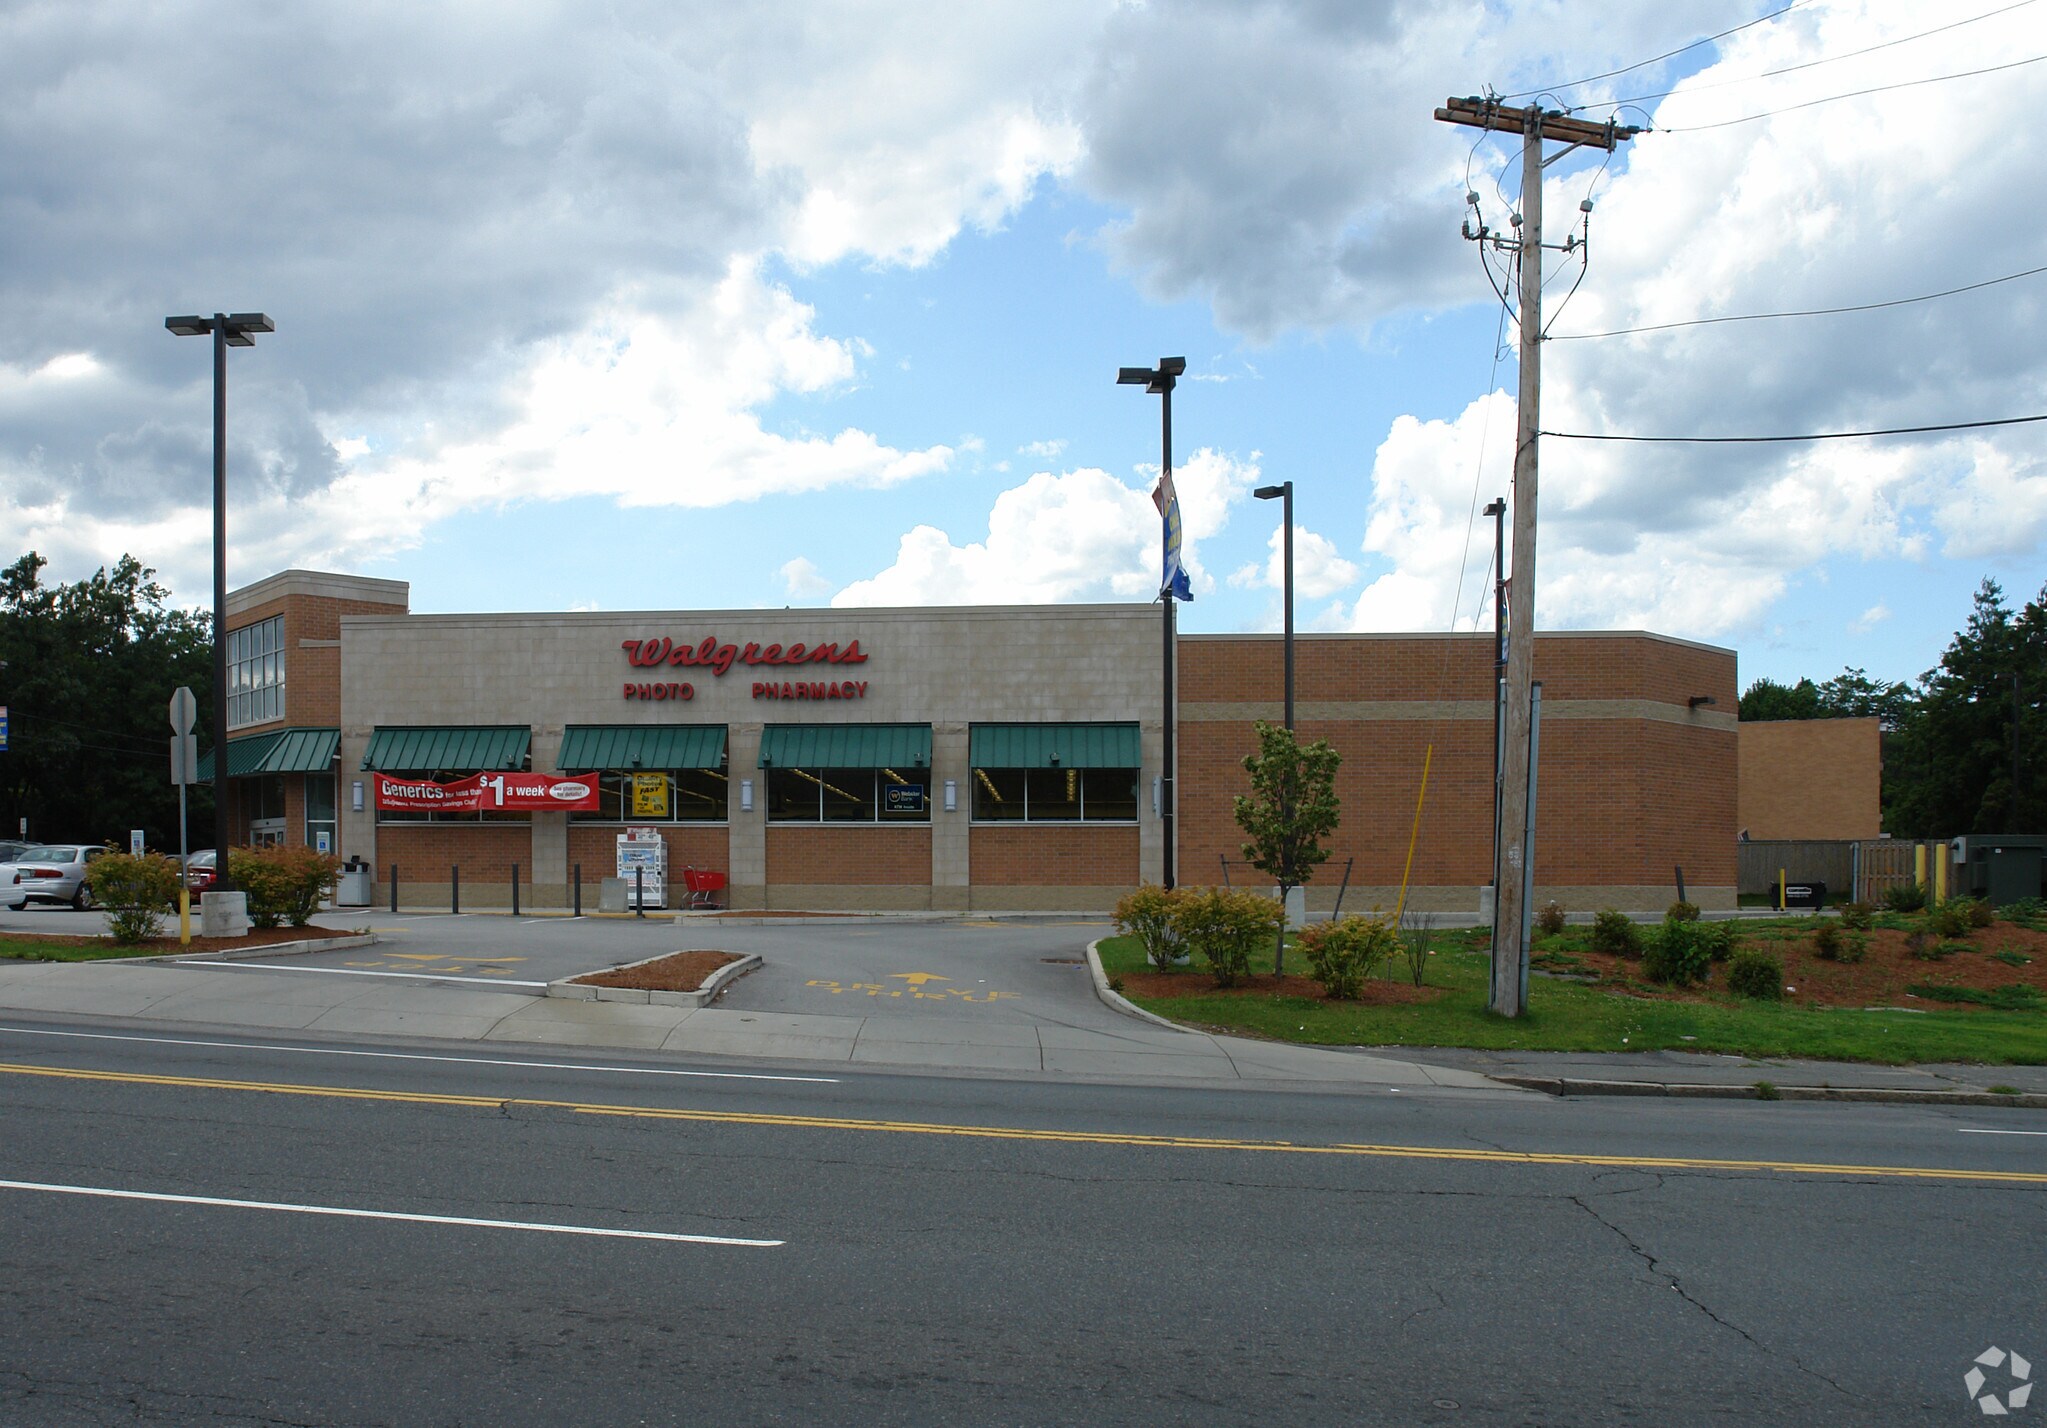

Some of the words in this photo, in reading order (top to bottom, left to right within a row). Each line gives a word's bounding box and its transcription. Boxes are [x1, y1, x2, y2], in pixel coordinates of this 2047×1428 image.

[621, 636, 869, 676] Walgreens
[623, 682, 695, 701] PHOTO
[752, 681, 868, 700] PHARMACY
[382, 780, 444, 799] Generics
[506, 786, 513, 796] a
[639, 786, 661, 795] FAST
